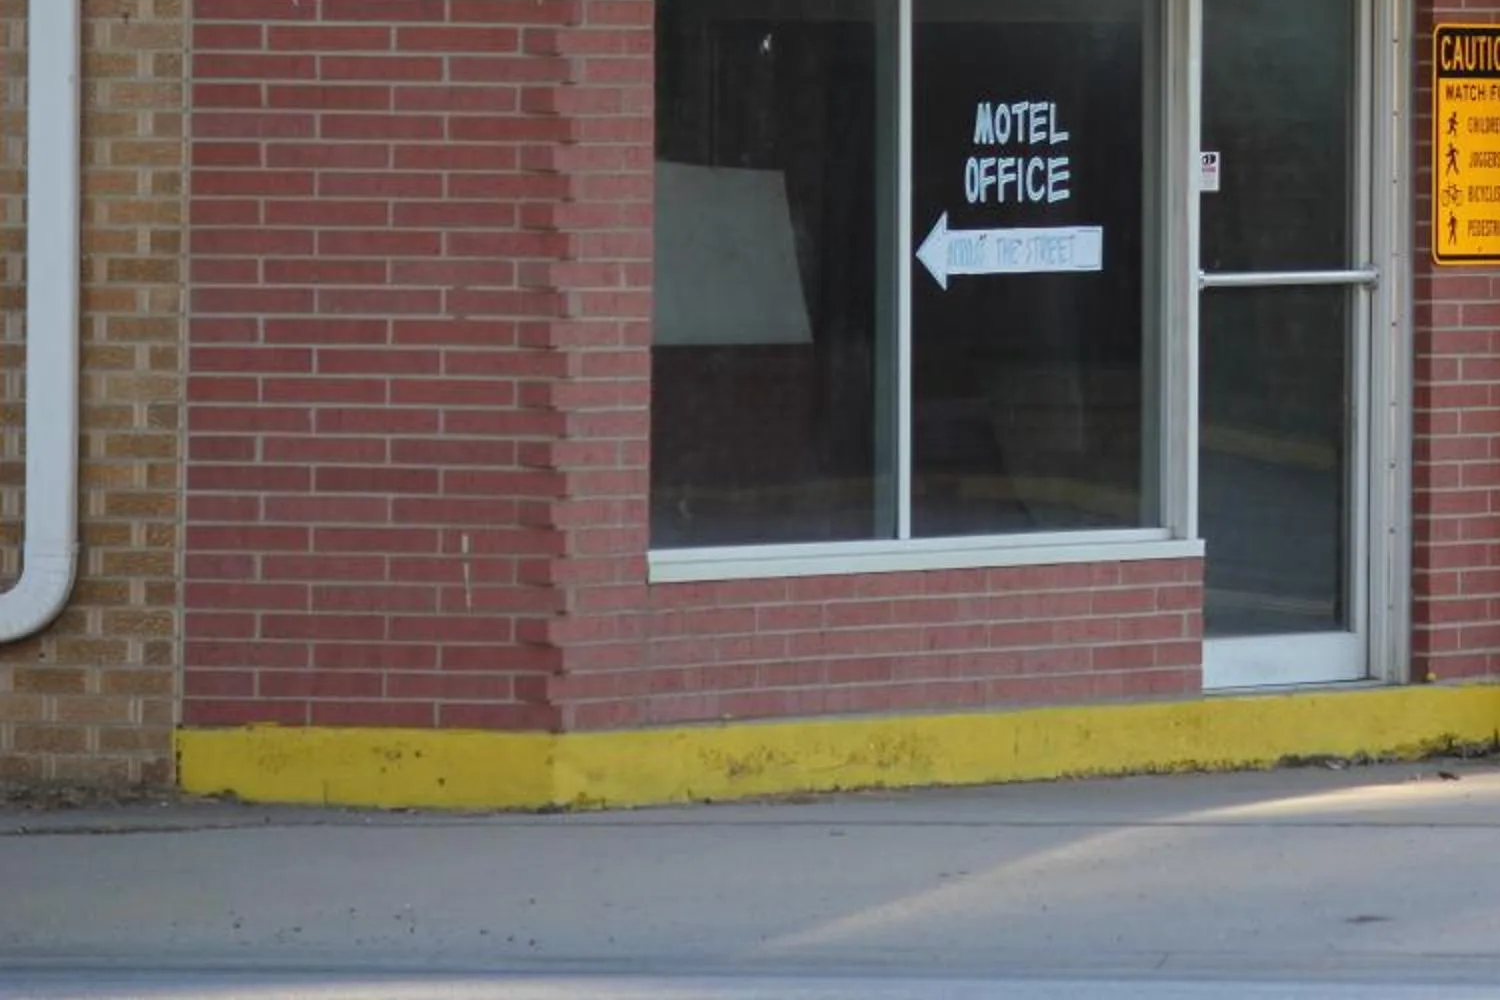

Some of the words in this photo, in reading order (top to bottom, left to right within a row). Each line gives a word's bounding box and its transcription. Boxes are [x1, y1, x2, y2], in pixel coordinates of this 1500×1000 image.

[1445, 84, 1486, 102] WATCH
[974, 101, 1069, 145] MOTEL
[965, 156, 1070, 204] OFFICE
